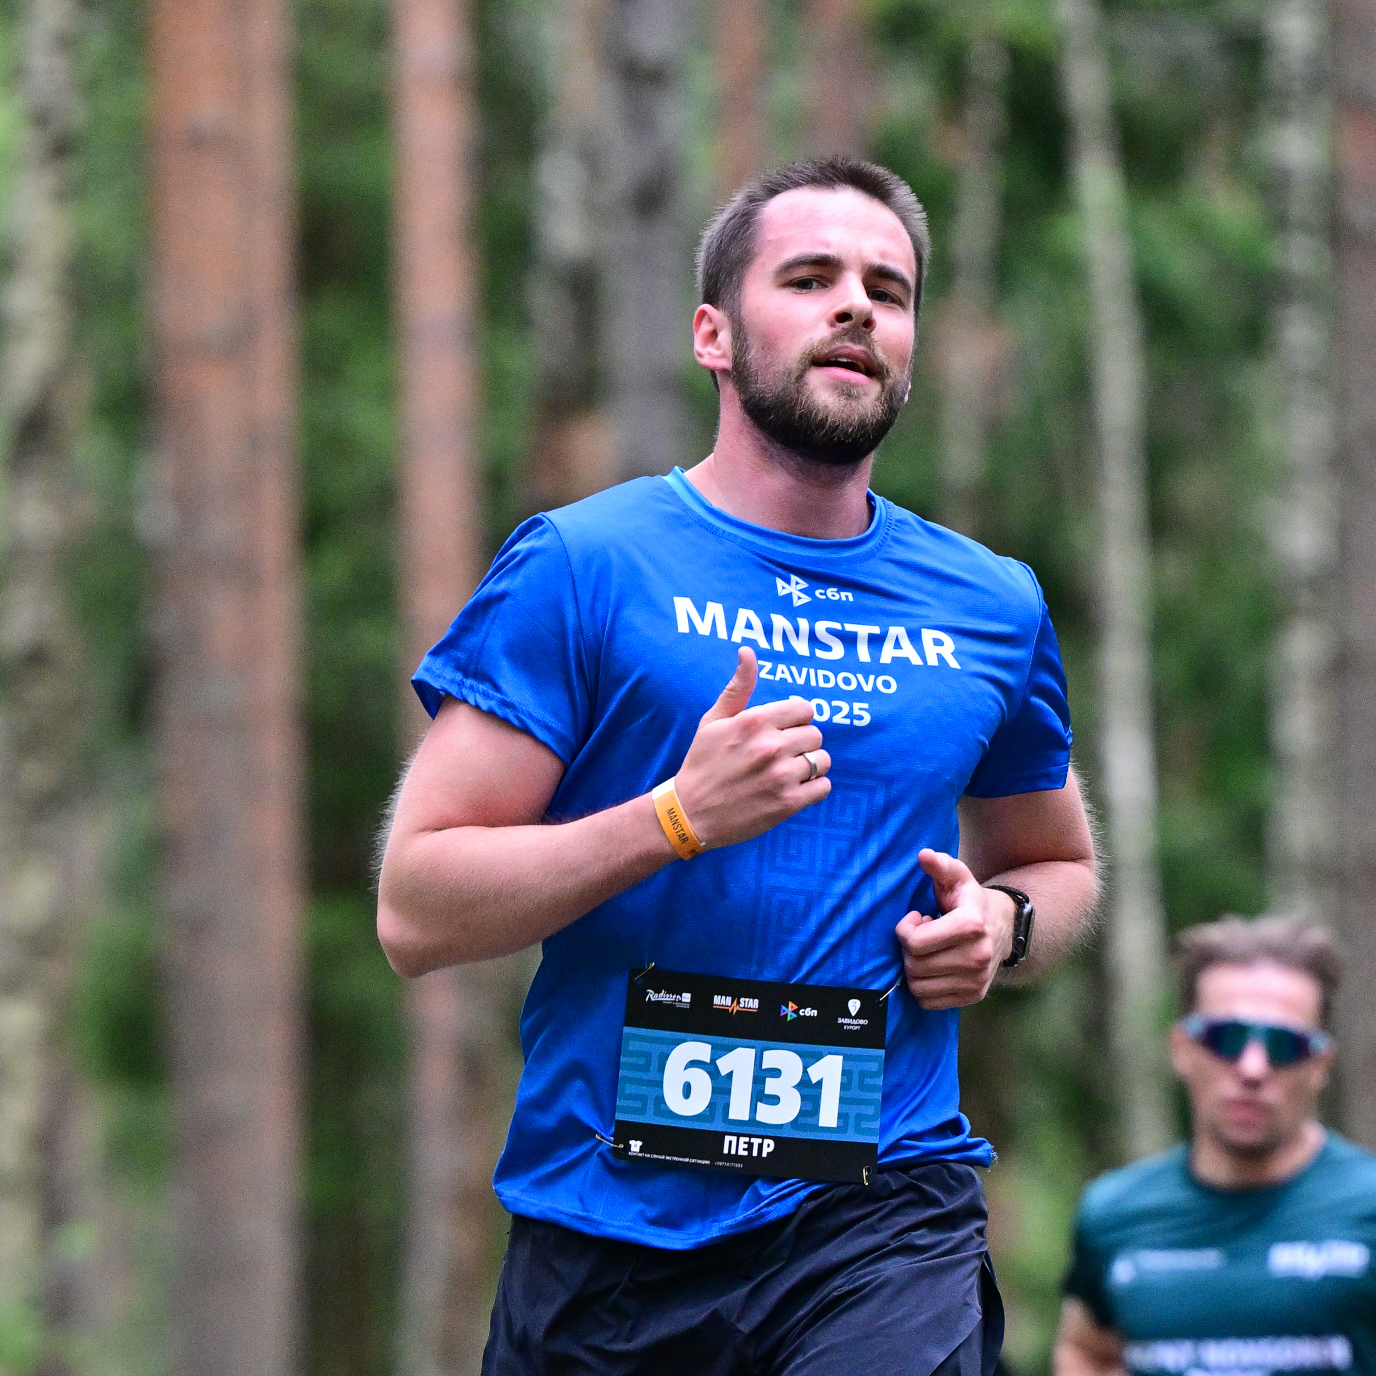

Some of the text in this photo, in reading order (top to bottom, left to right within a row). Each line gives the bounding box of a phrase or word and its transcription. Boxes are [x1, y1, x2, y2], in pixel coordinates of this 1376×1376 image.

[673, 596, 962, 670] MANSTAR
[757, 660, 898, 694] ZAVIDOVO
[788, 695, 871, 727] 025
[666, 807, 689, 845] MANSTAR
[713, 995, 759, 1009] MAN STAR
[837, 1017, 869, 1025] ЗАВИДОВО
[662, 1041, 844, 1128] 6131
[723, 1135, 775, 1158] ПЕТР
